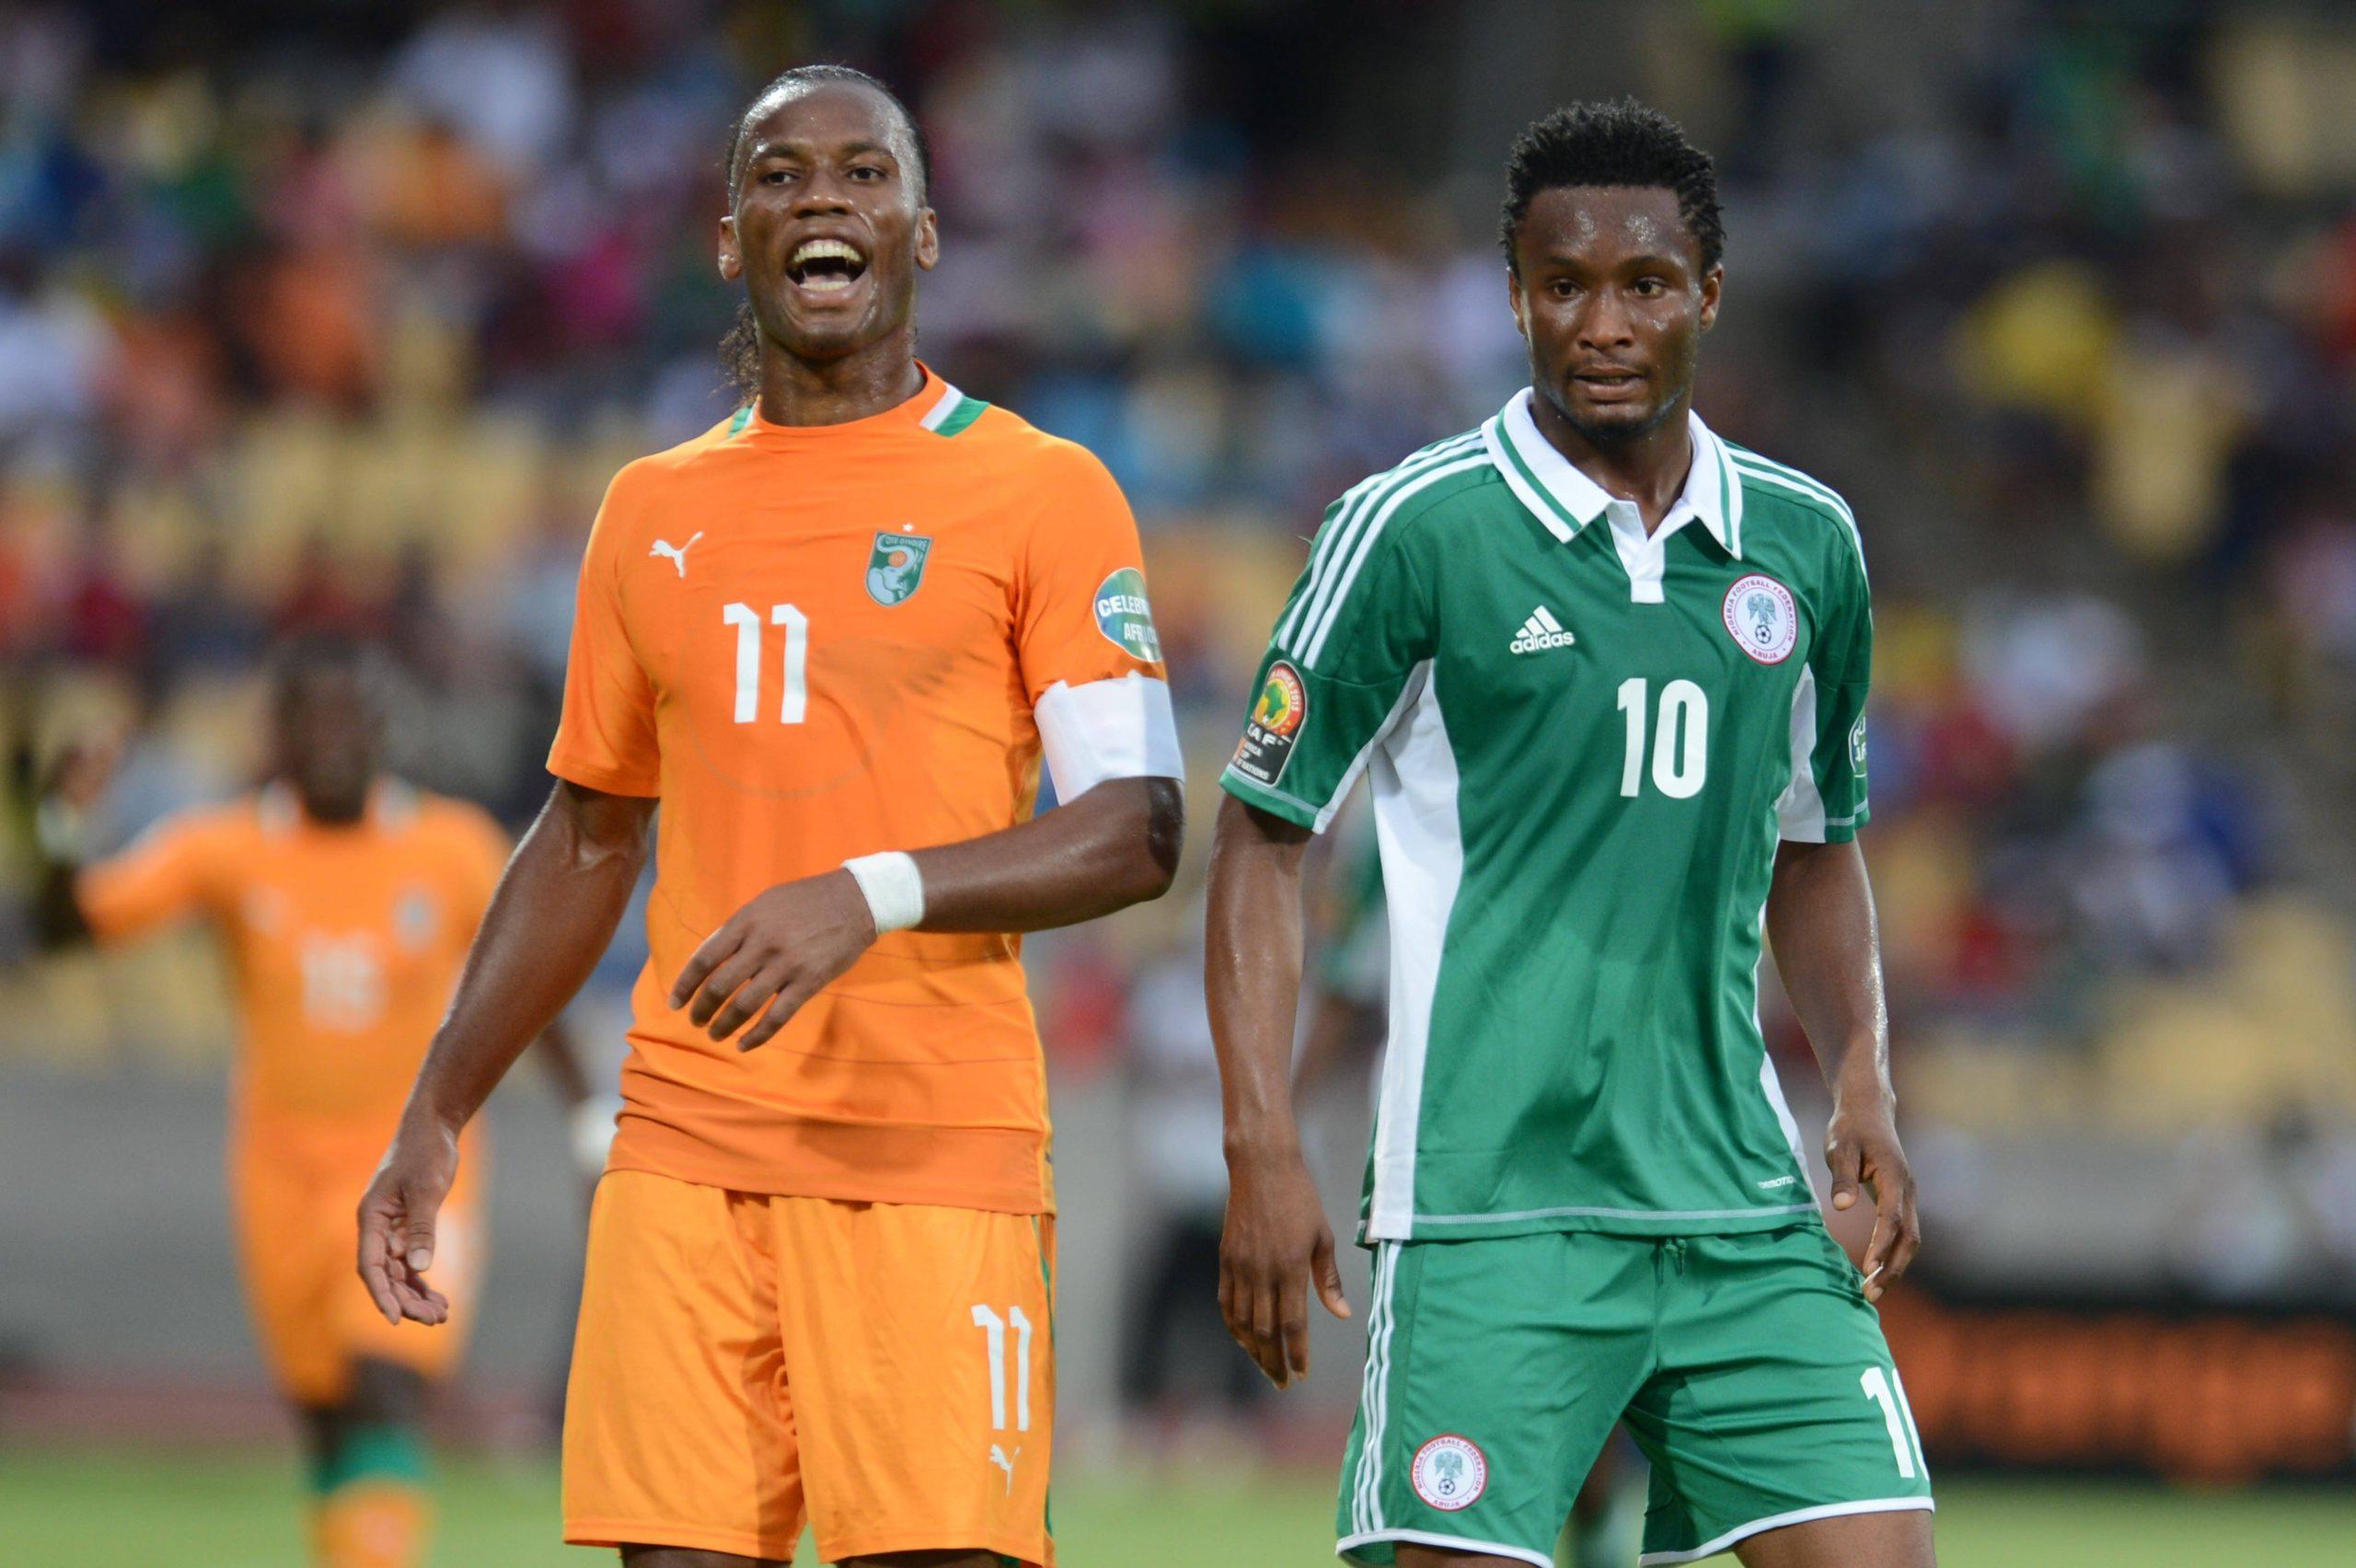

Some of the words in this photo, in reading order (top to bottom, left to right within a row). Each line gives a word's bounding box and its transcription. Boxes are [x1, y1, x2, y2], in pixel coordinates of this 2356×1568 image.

[1727, 599, 1739, 636] NIGERIA
[1733, 580, 1770, 597] FOOTBALL
[1773, 586, 1794, 641] FEDERATION
[722, 602, 808, 724] 11
[1509, 631, 1576, 654] adidas
[1752, 648, 1778, 659] ABUJA
[1617, 677, 1708, 799] 10
[971, 1304, 1032, 1431] 11
[1423, 1438, 1461, 1455] FOOTBALL
